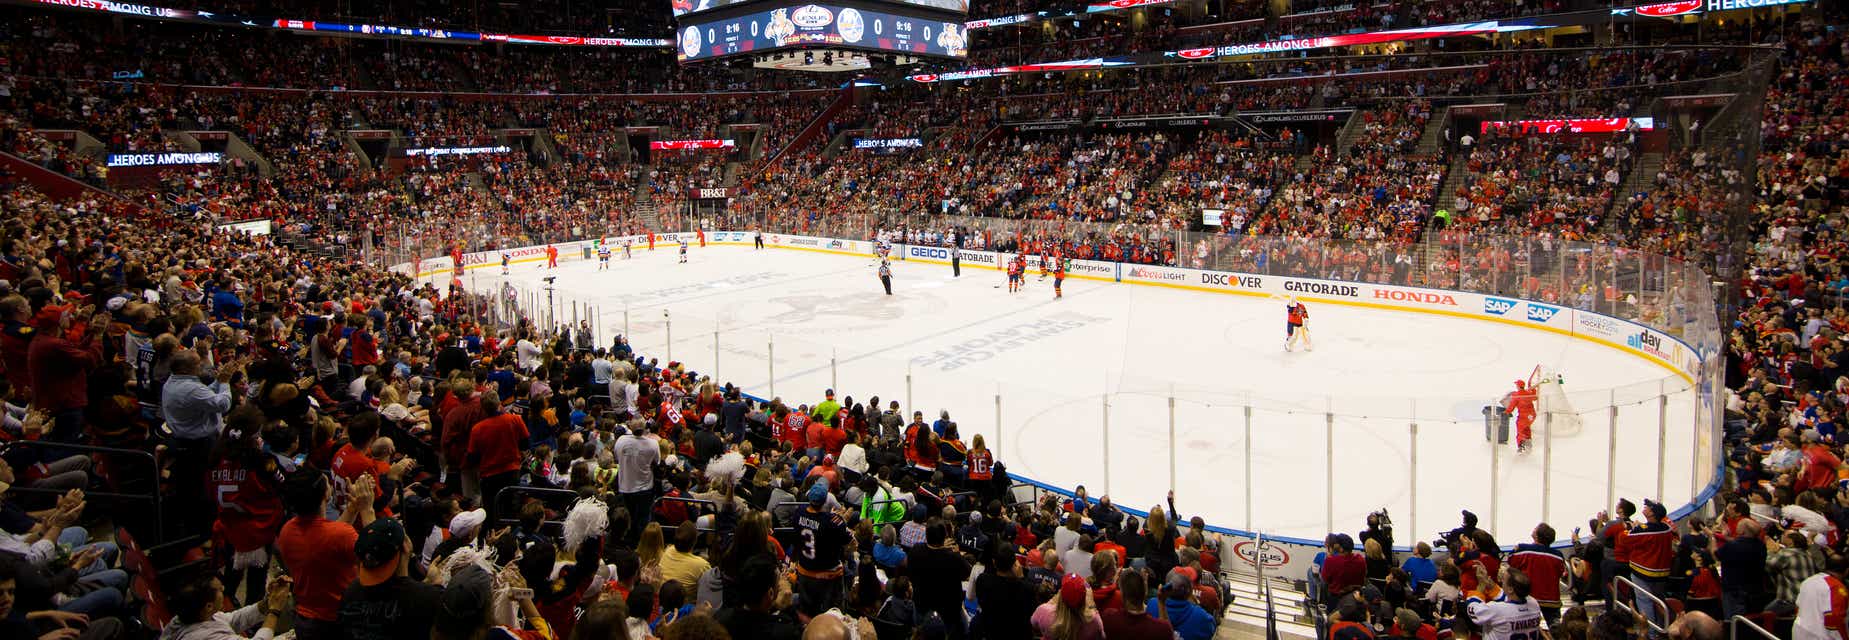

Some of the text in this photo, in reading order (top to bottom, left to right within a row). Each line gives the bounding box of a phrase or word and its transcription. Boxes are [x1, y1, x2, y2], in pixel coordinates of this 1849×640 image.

[40, 0, 174, 17] ROES AMONG US
[751, 21, 757, 36] 0
[875, 19, 882, 34] 0
[896, 21, 912, 31] 9:16
[965, 20, 985, 29] ROES
[709, 29, 715, 43] 0
[923, 26, 931, 40] 0
[584, 38, 618, 46] HEROES
[1217, 44, 1260, 56] HEROES
[1264, 39, 1309, 52] AMONG
[113, 153, 155, 166] HEROES
[157, 152, 201, 164] AMONG
[700, 188, 727, 198] BB&T
[638, 233, 678, 244] DIOVER
[511, 247, 547, 257] ONDA
[911, 247, 948, 259] GEICO
[959, 252, 994, 263] ATORADE
[1163, 272, 1186, 281] LIGHT
[1202, 273, 1262, 289] DISCOVER
[1284, 281, 1359, 297] GATORADE
[1373, 289, 1459, 306] HONDA
[1485, 300, 1510, 314] SAP
[1528, 306, 1553, 320] SAP
[1641, 329, 1661, 350] day
[973, 458, 987, 473] 16
[211, 469, 247, 481] EKBLAD
[801, 529, 816, 560] 3
